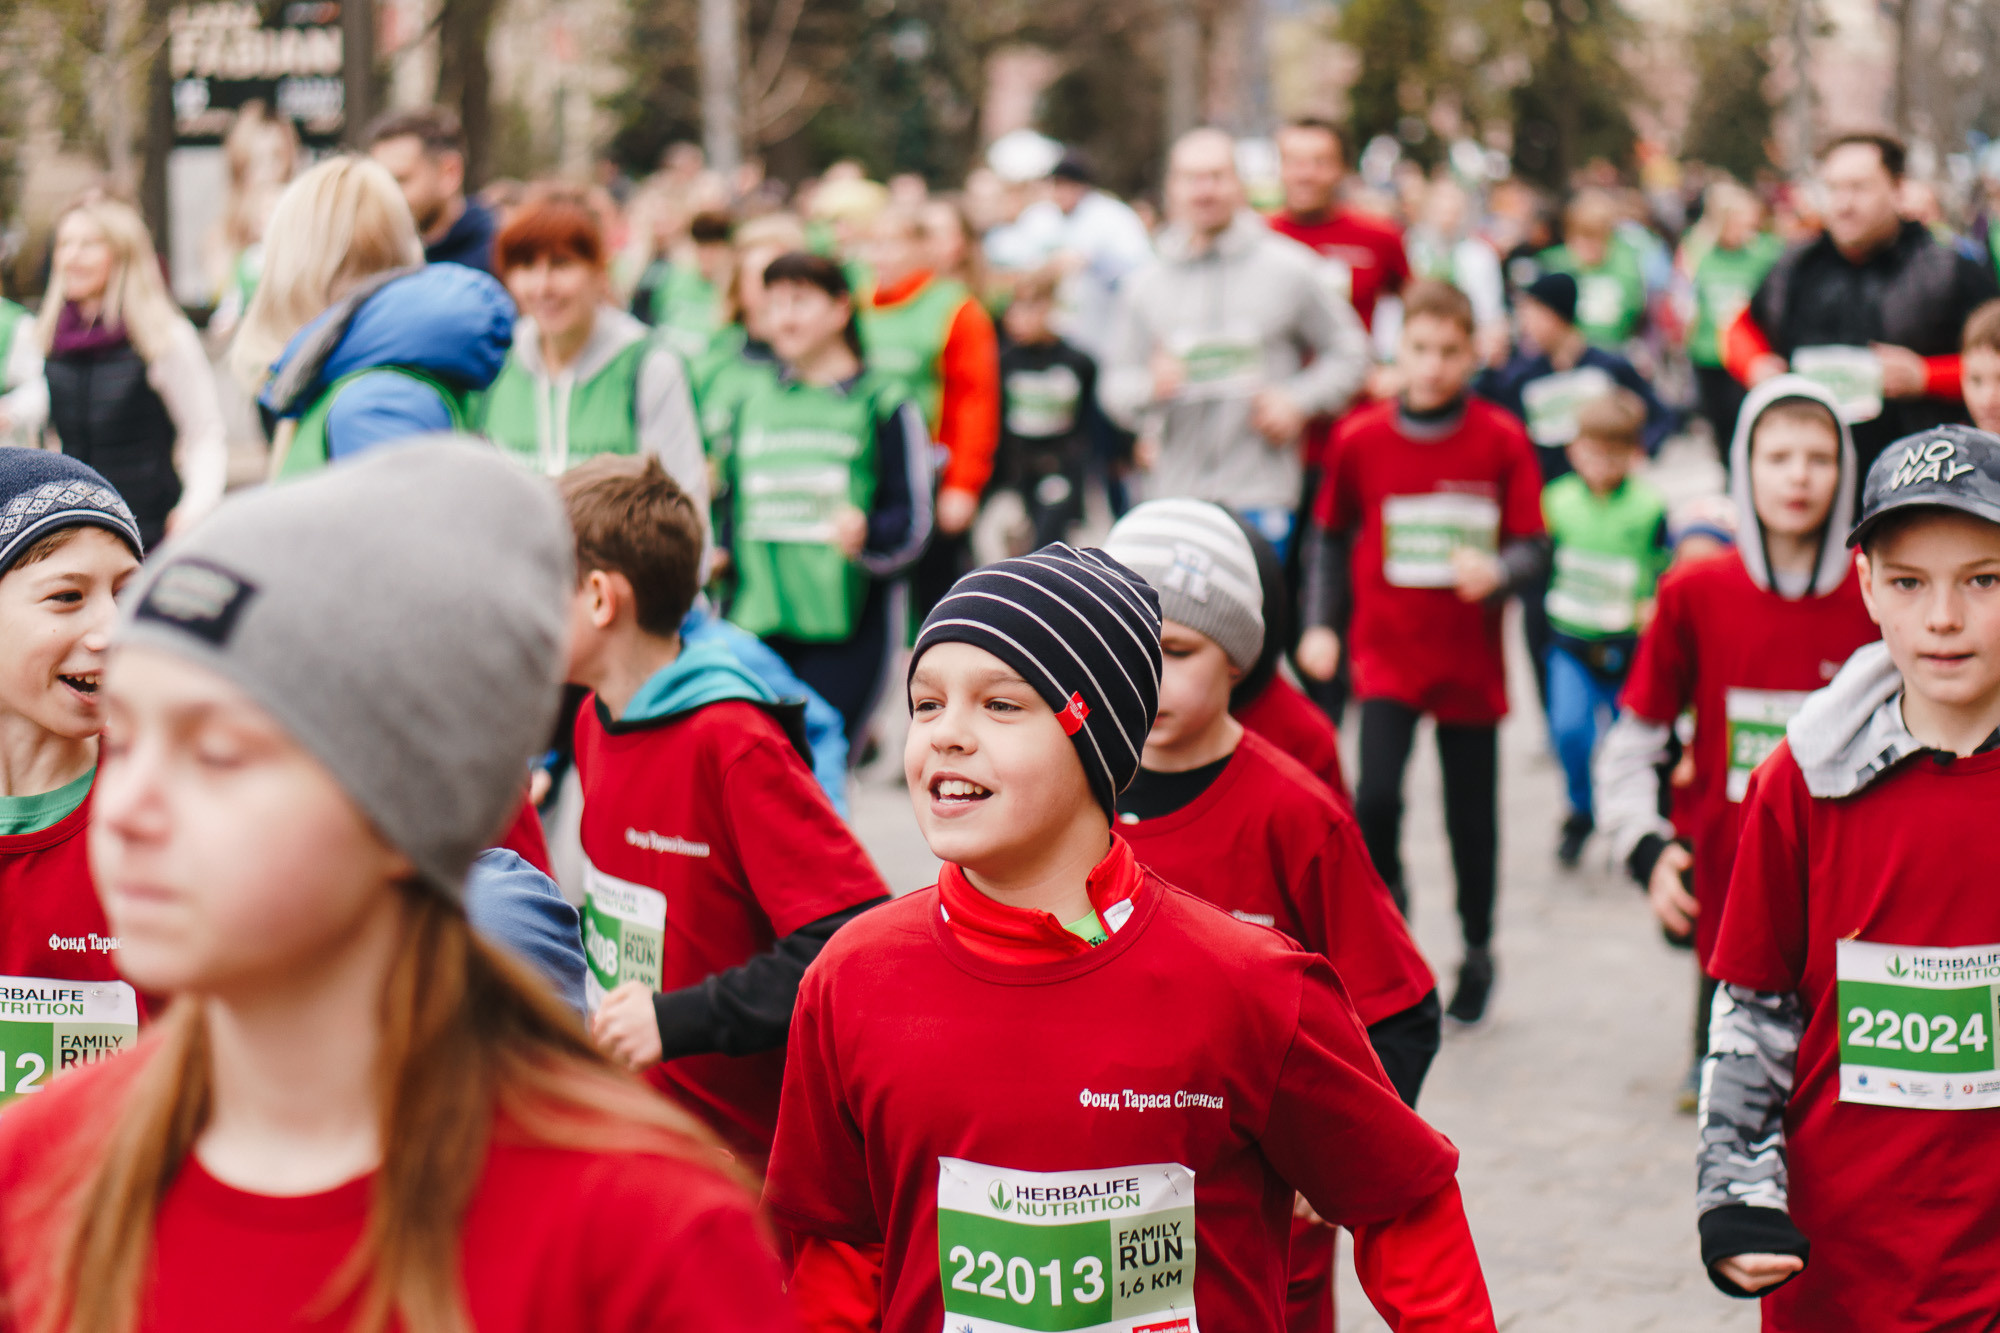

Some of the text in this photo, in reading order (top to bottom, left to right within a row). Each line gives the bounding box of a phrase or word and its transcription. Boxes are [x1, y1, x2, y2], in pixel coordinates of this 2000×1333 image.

[1898, 439, 1955, 470] NO
[1891, 460, 1976, 492] WAY
[49, 932, 124, 954] Фонд Тарас
[624, 942, 656, 968] RUN
[61, 1035, 123, 1048] FAMILY
[1847, 1006, 1989, 1054] 22024
[1079, 1088, 1224, 1112] Фонд Тараса Сітенка
[1016, 1177, 1140, 1202] HERBALIFE
[1016, 1193, 1141, 1217] NUTRITION
[1119, 1221, 1182, 1246] FAMILY
[1119, 1236, 1184, 1272] RUN
[949, 1245, 1105, 1307] 22013
[1119, 1268, 1183, 1298] 1,6 KM
